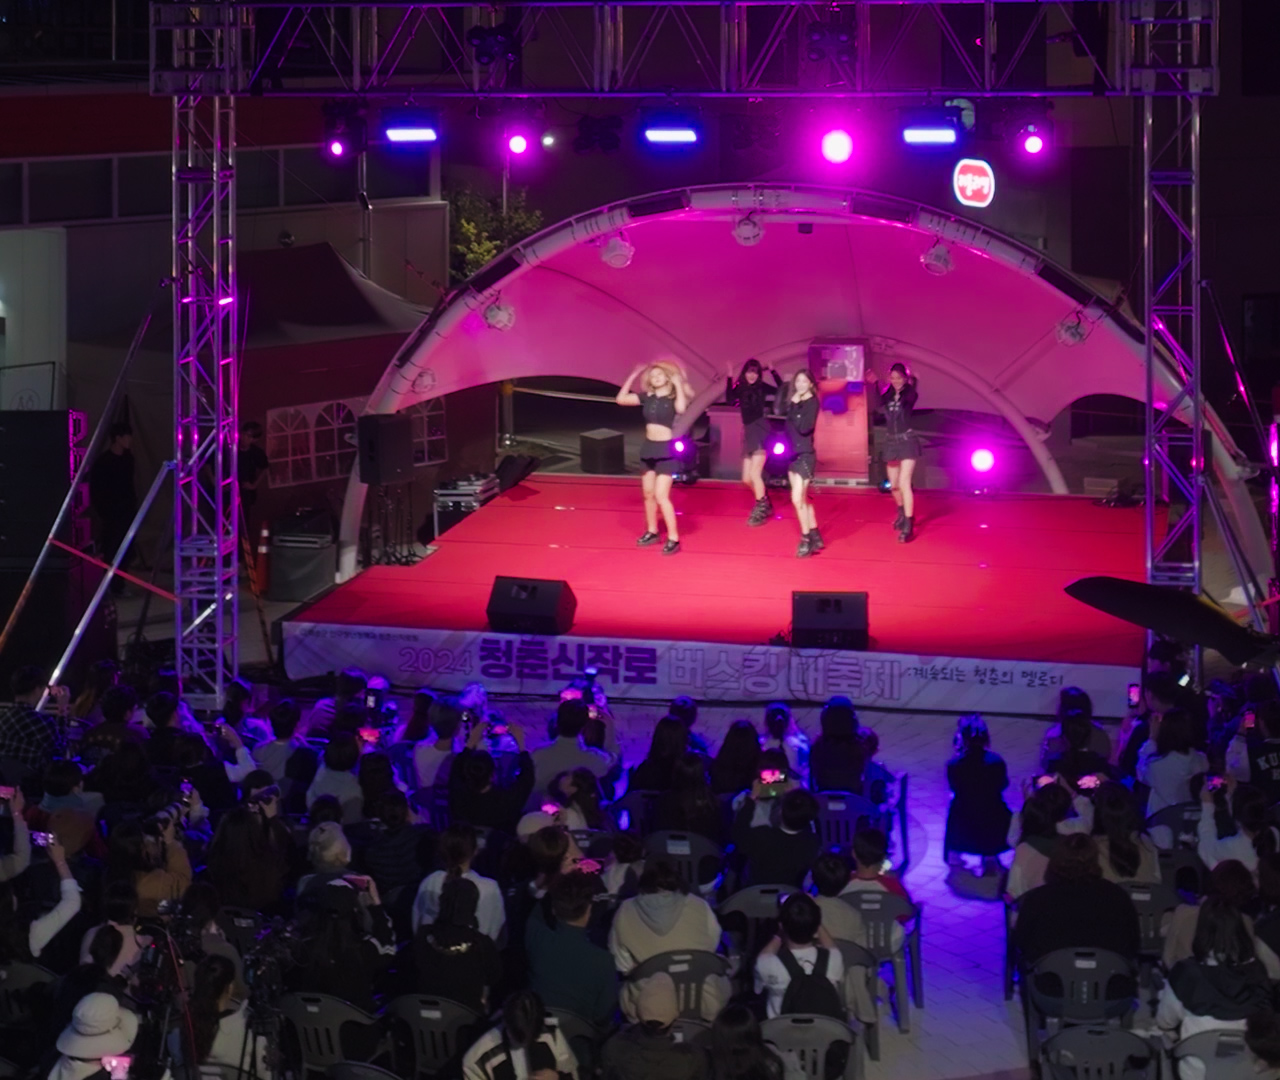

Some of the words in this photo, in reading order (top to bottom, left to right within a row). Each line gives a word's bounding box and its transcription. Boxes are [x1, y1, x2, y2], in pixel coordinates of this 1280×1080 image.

[399, 646, 472, 675] 2024
[479, 638, 658, 685] 청춘신작로
[669, 648, 779, 696] 버스킹
[789, 654, 902, 701] 대축제
[974, 665, 1014, 686] 청춘의
[1021, 670, 1064, 688] 멜로디
